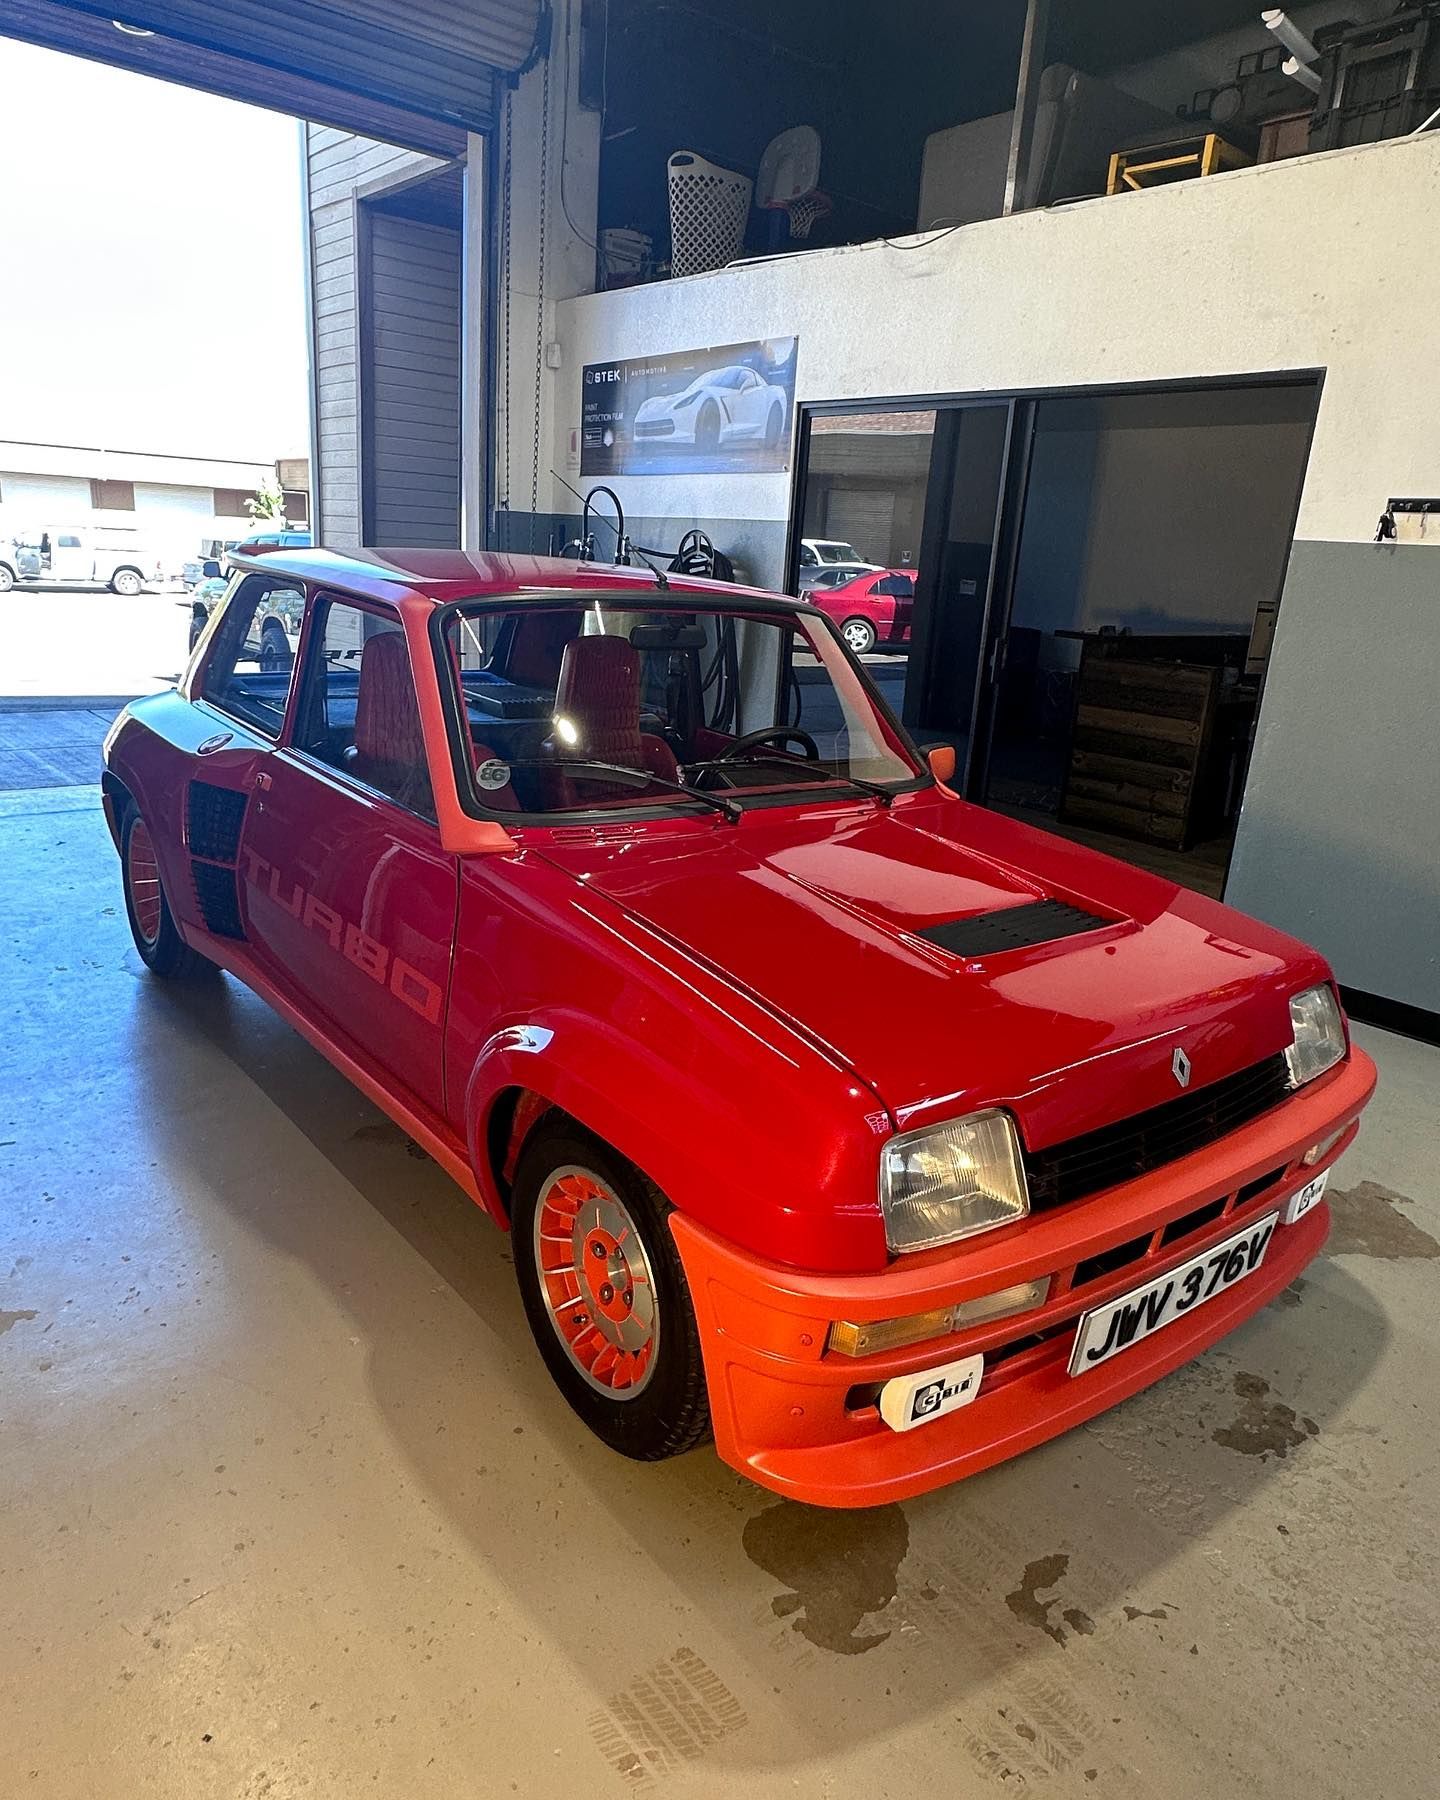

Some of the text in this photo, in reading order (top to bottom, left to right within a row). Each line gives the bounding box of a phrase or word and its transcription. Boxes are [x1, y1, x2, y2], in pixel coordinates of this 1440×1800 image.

[594, 369, 621, 383] STEK
[631, 366, 667, 377] AUTOMOTIVE
[243, 846, 444, 1022] TURBO
[1086, 1225, 1273, 1361] JWV 376V
